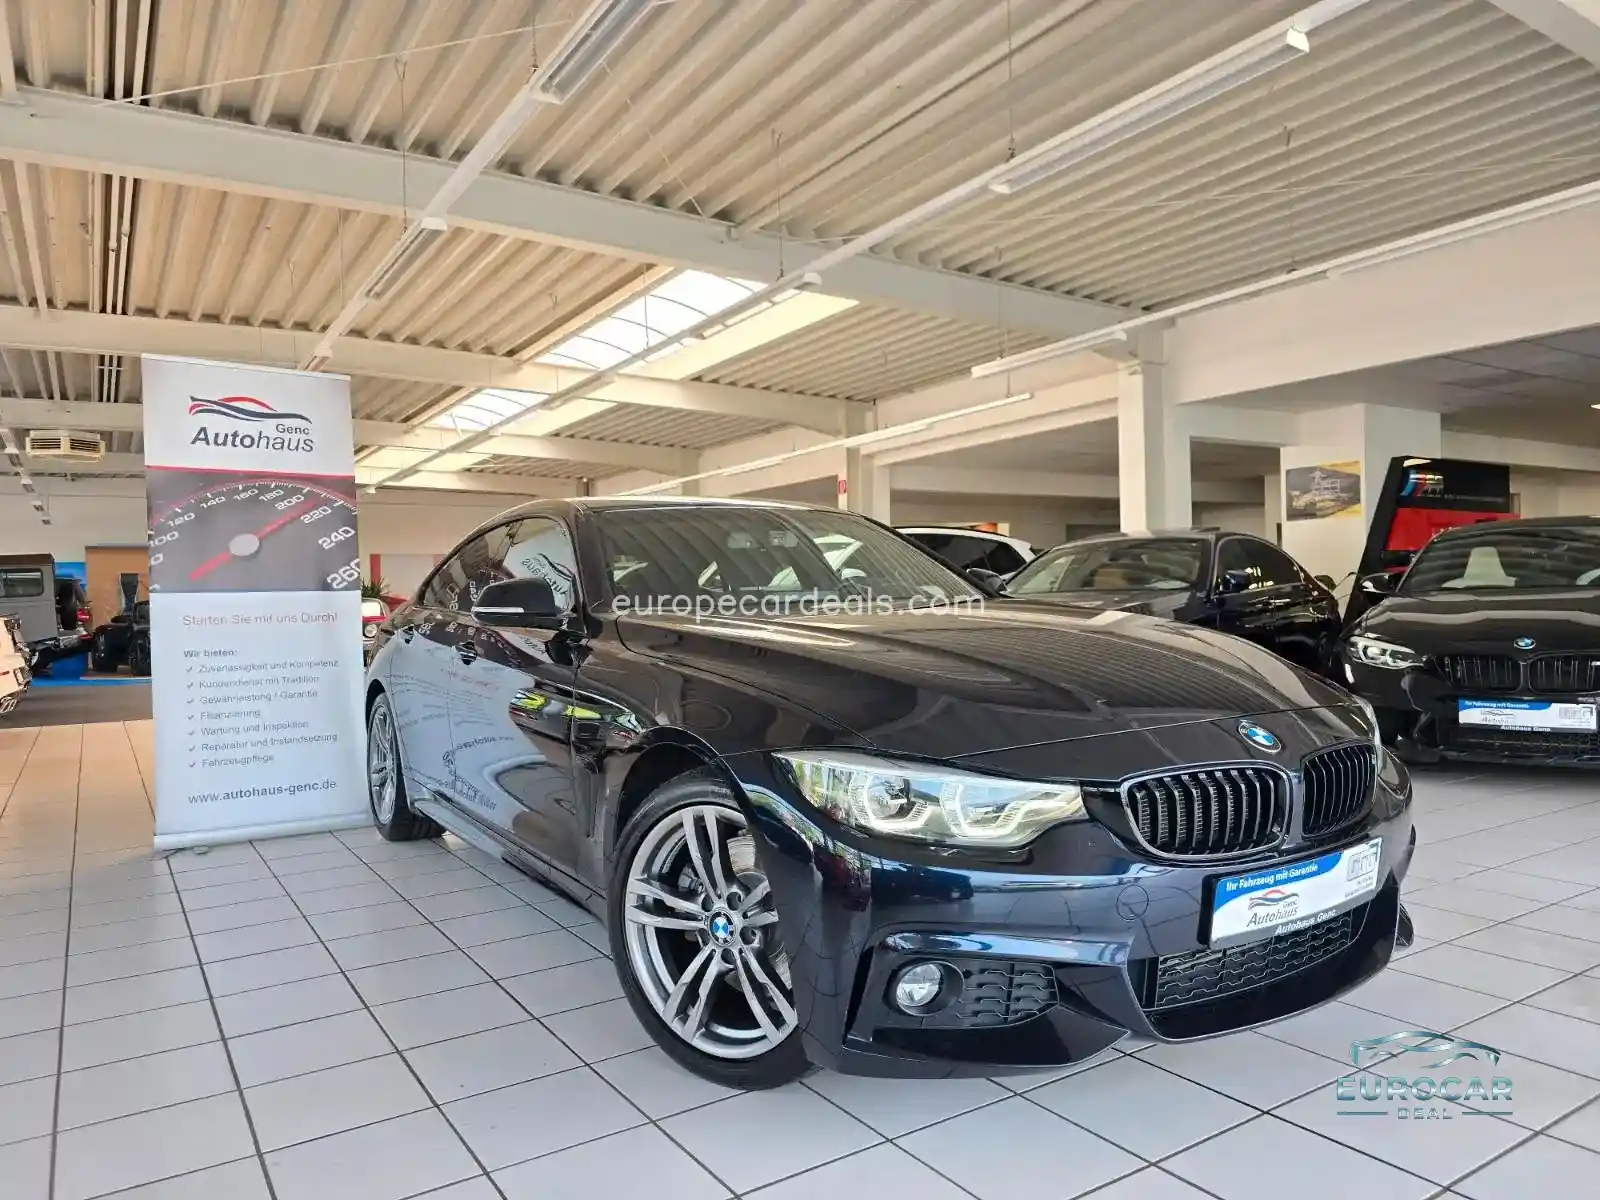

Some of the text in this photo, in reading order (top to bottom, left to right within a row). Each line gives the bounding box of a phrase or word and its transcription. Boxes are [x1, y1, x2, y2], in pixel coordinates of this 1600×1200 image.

[275, 423, 310, 435] Genc
[190, 425, 314, 453] Autohaus
[199, 496, 226, 509] 140
[232, 488, 259, 501] 160
[258, 488, 284, 502] 180
[274, 493, 305, 511] 200
[300, 505, 332, 524] 220
[318, 526, 356, 550] 240
[182, 614, 228, 627] Starten
[231, 613, 252, 625] Sie
[276, 613, 298, 624] uns
[301, 611, 338, 624] Durch!
[183, 648, 238, 659] Wir bieten:
[270, 660, 287, 670] und
[201, 720, 309, 736] Wartung und Inspektion
[201, 732, 338, 752] Reparatur und Instandsetzung
[188, 778, 337, 804] www.autohaus-genc.de
[1226, 863, 1319, 892] Ihr Fahrzeug mit Garantie
[1246, 908, 1298, 927] Autohaus
[1275, 909, 1337, 935] Autohaus Genc
